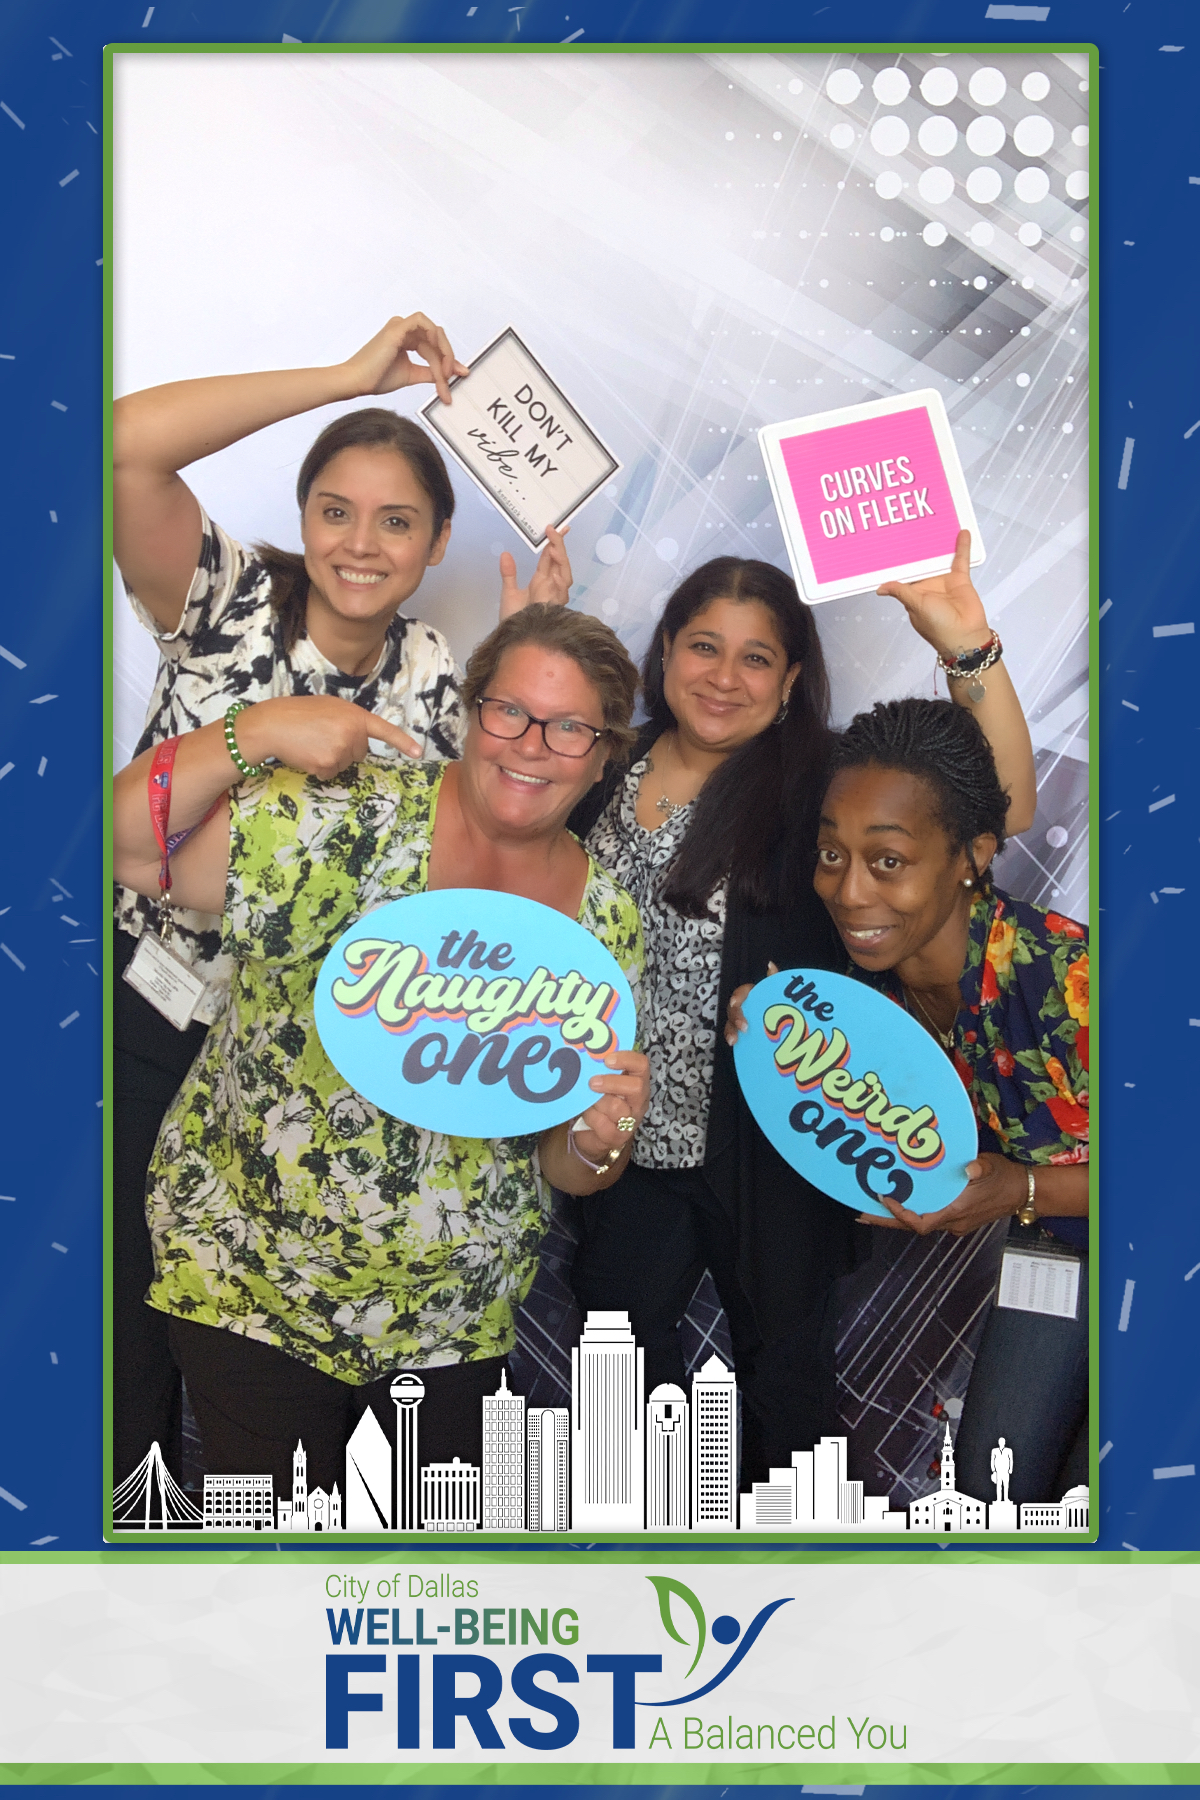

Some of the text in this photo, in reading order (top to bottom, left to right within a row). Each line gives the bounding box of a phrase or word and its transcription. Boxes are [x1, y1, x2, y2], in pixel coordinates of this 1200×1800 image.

[486, 397, 558, 477] KILL MY
[514, 384, 573, 451] DON'T
[819, 487, 935, 539] ON FLEEK
[820, 456, 915, 502] CURVES
[436, 929, 516, 971] the
[331, 937, 621, 1063] Naughty
[783, 975, 835, 1022] the
[402, 1032, 581, 1104] one
[763, 1003, 946, 1172] Weird
[789, 1100, 914, 1205] one
